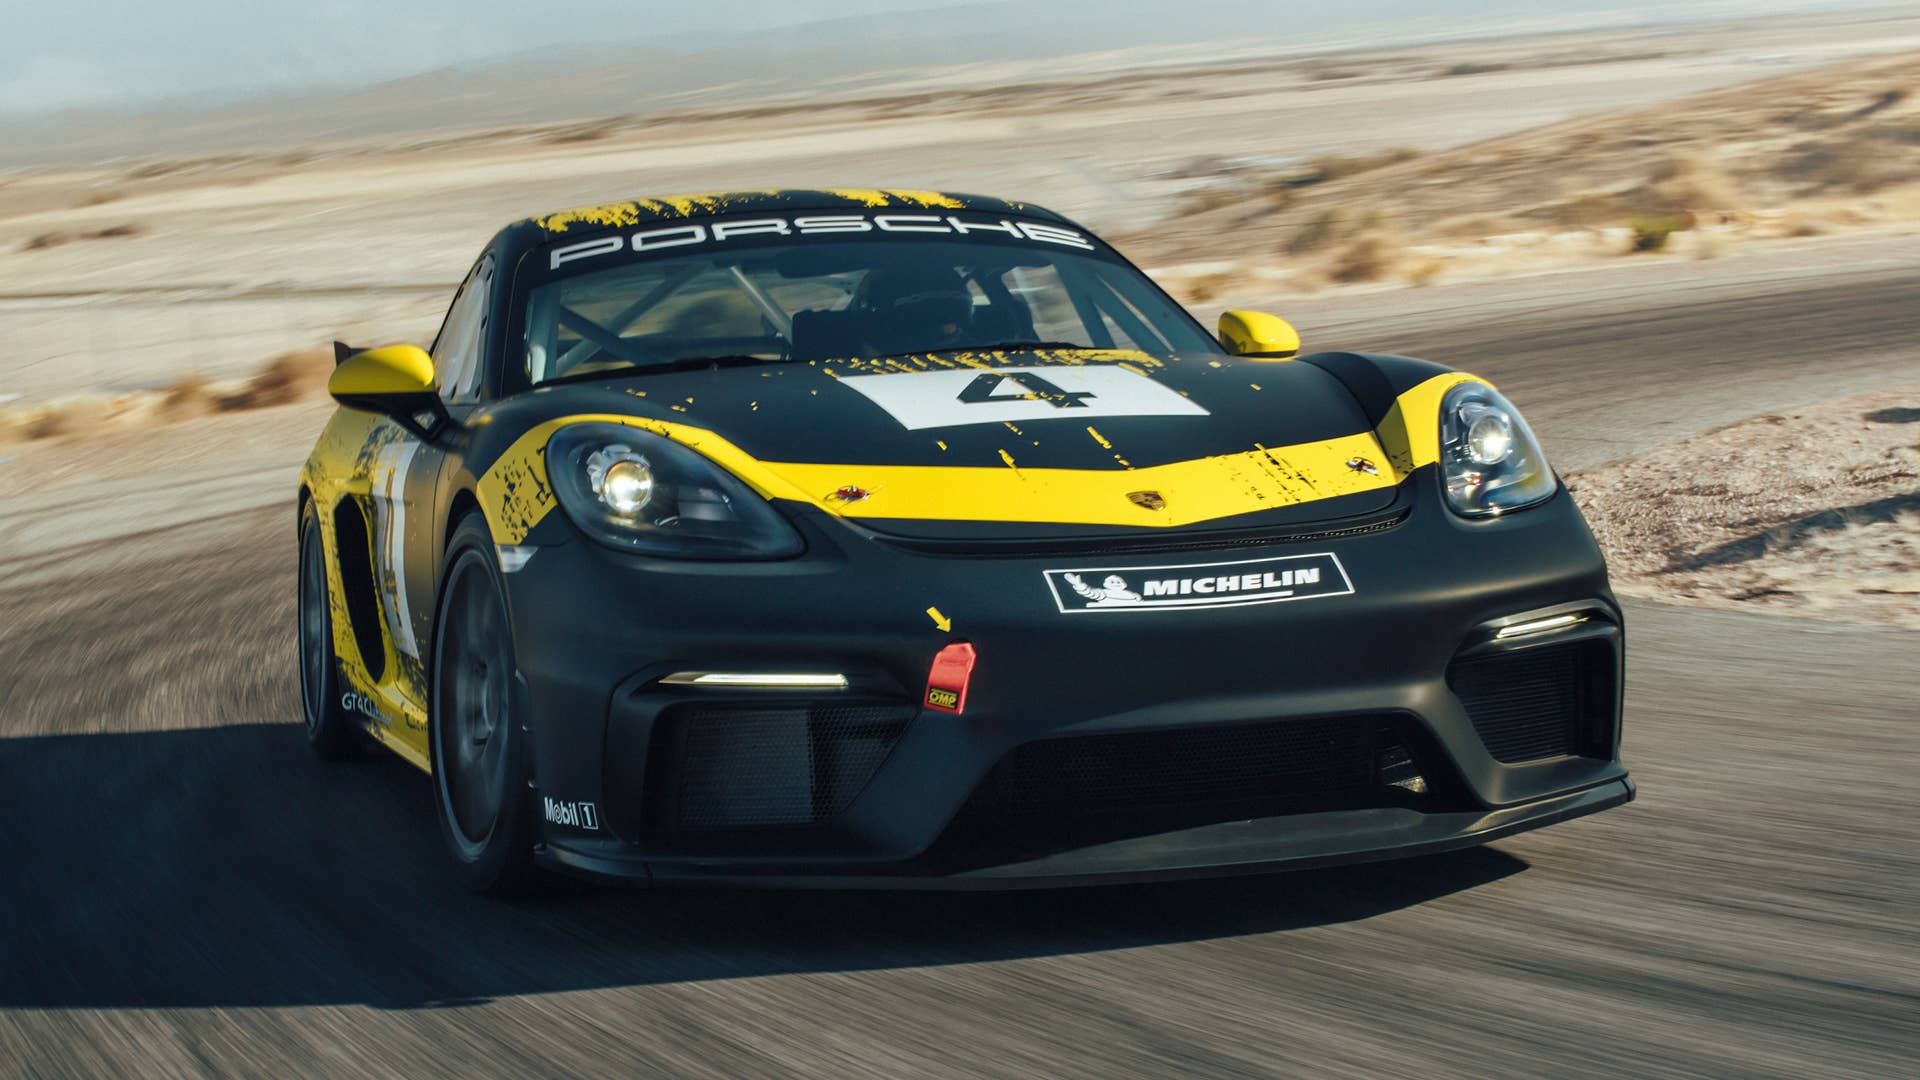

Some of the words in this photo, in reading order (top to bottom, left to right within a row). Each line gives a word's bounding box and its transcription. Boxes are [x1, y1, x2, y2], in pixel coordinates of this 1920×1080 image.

[550, 214, 1095, 271] PORSCHE
[956, 371, 1098, 409] 4
[1143, 567, 1320, 597] MICHELIN
[929, 691, 957, 705] OMP
[544, 796, 579, 827] Mobil
